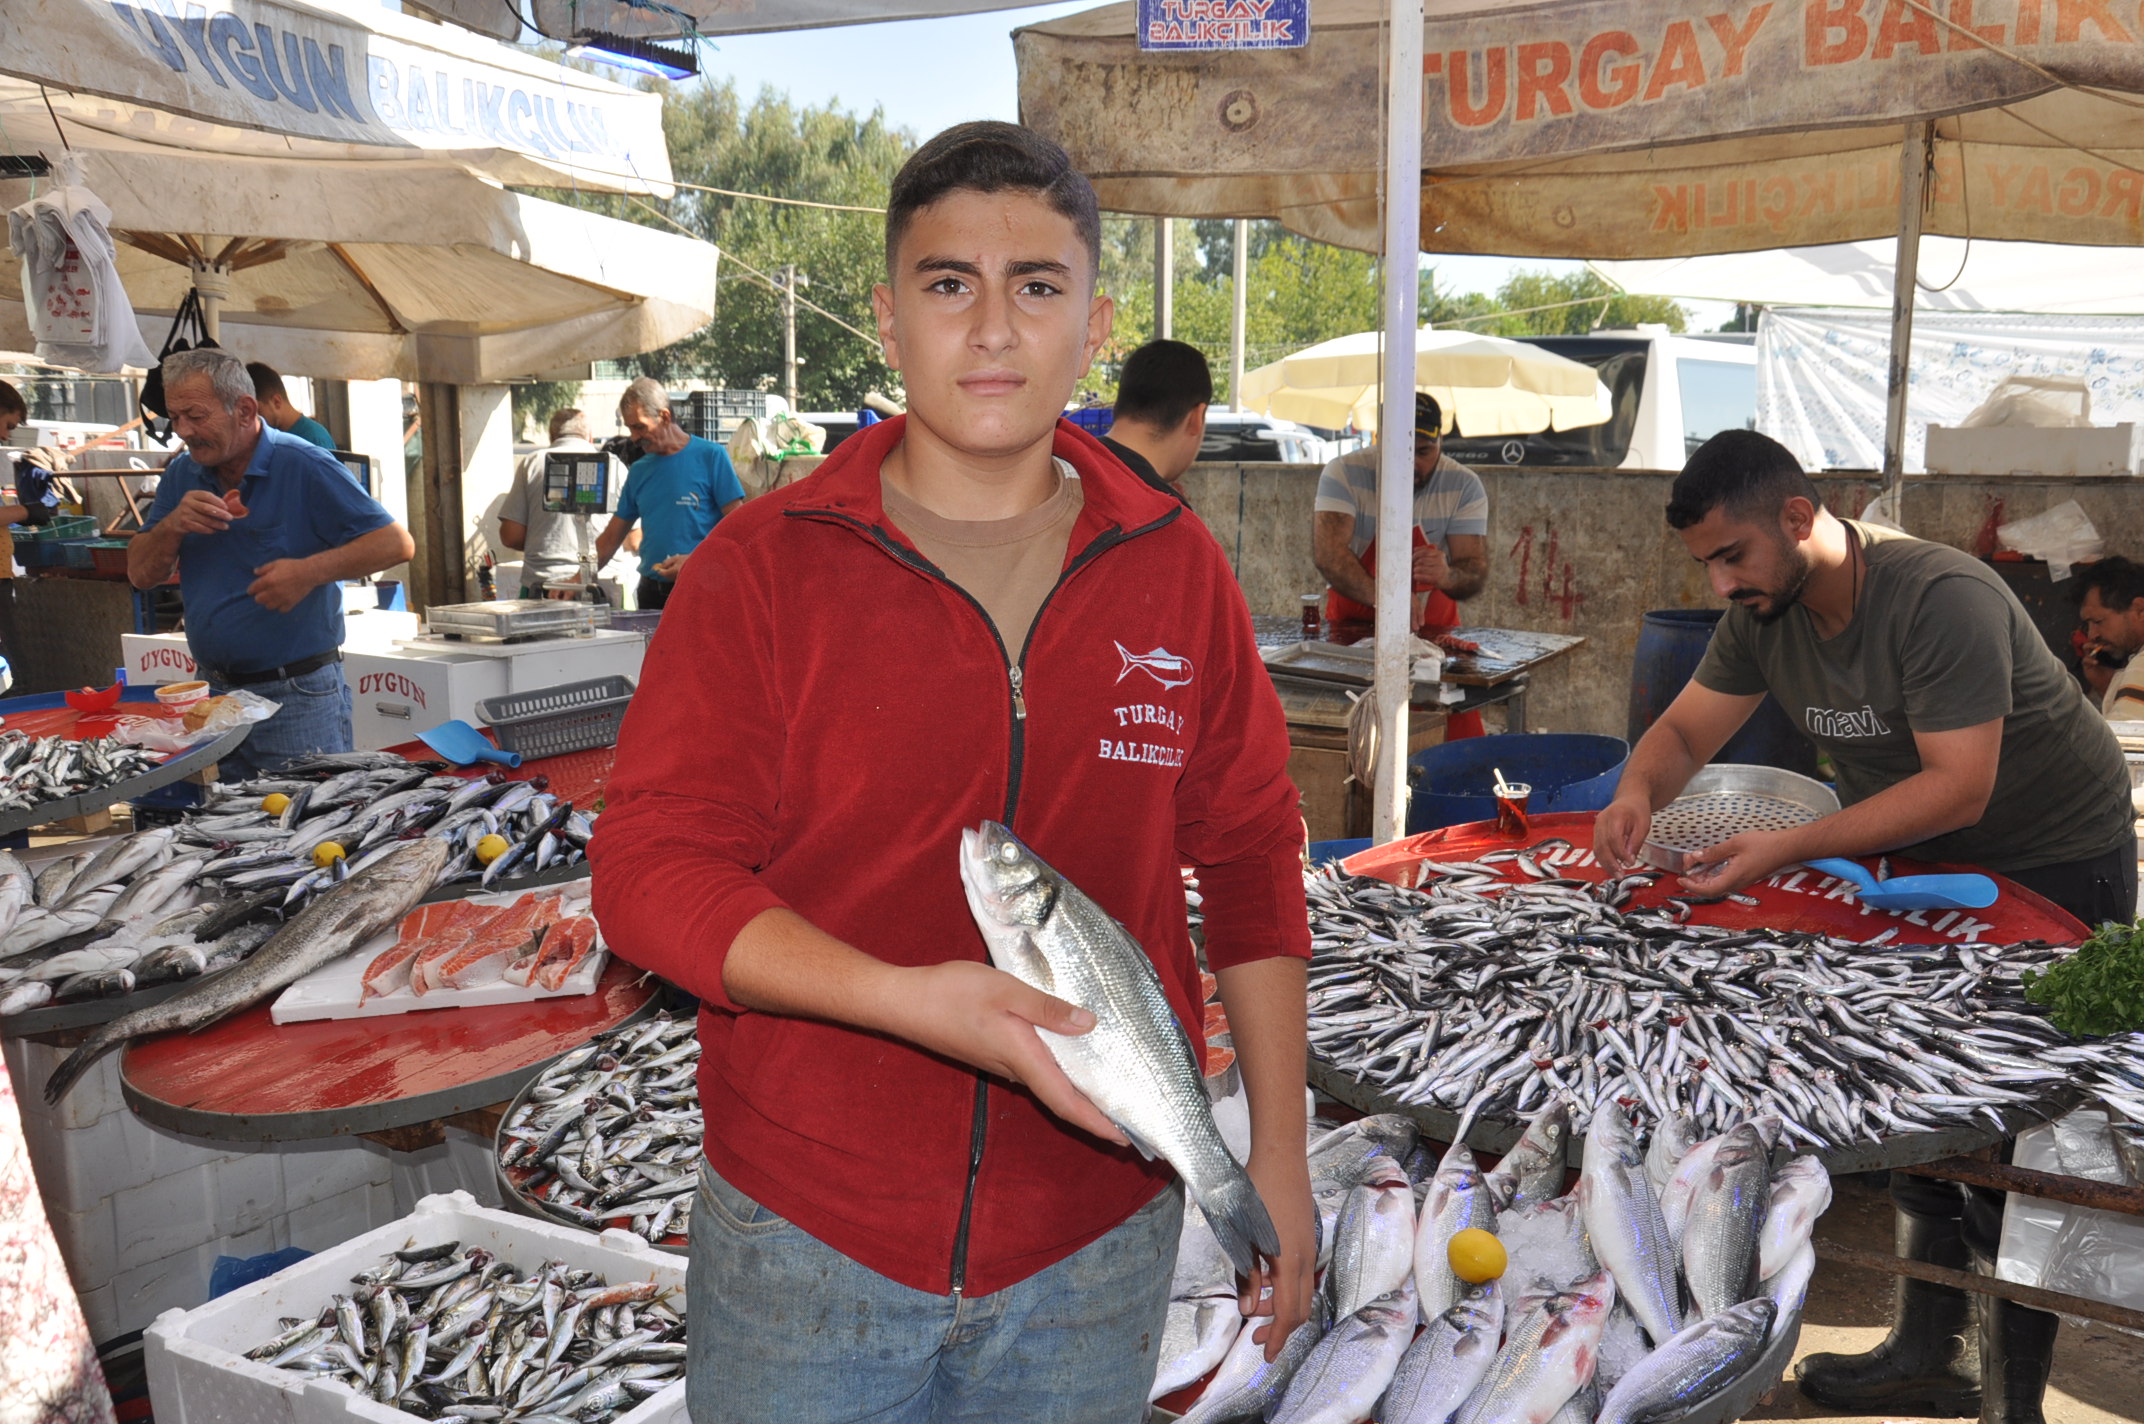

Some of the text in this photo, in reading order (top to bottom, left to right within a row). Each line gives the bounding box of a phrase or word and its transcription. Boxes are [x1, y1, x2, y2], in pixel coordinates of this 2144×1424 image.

[1161, 0, 1274, 21] TURGAY
[1805, 0, 2144, 67] BALIK
[109, 0, 368, 124] UYGUN
[141, 648, 197, 673] UYGUN
[360, 672, 426, 710] UYGUN
[1113, 703, 1185, 735] TURGAY
[1805, 704, 1891, 738] mavi
